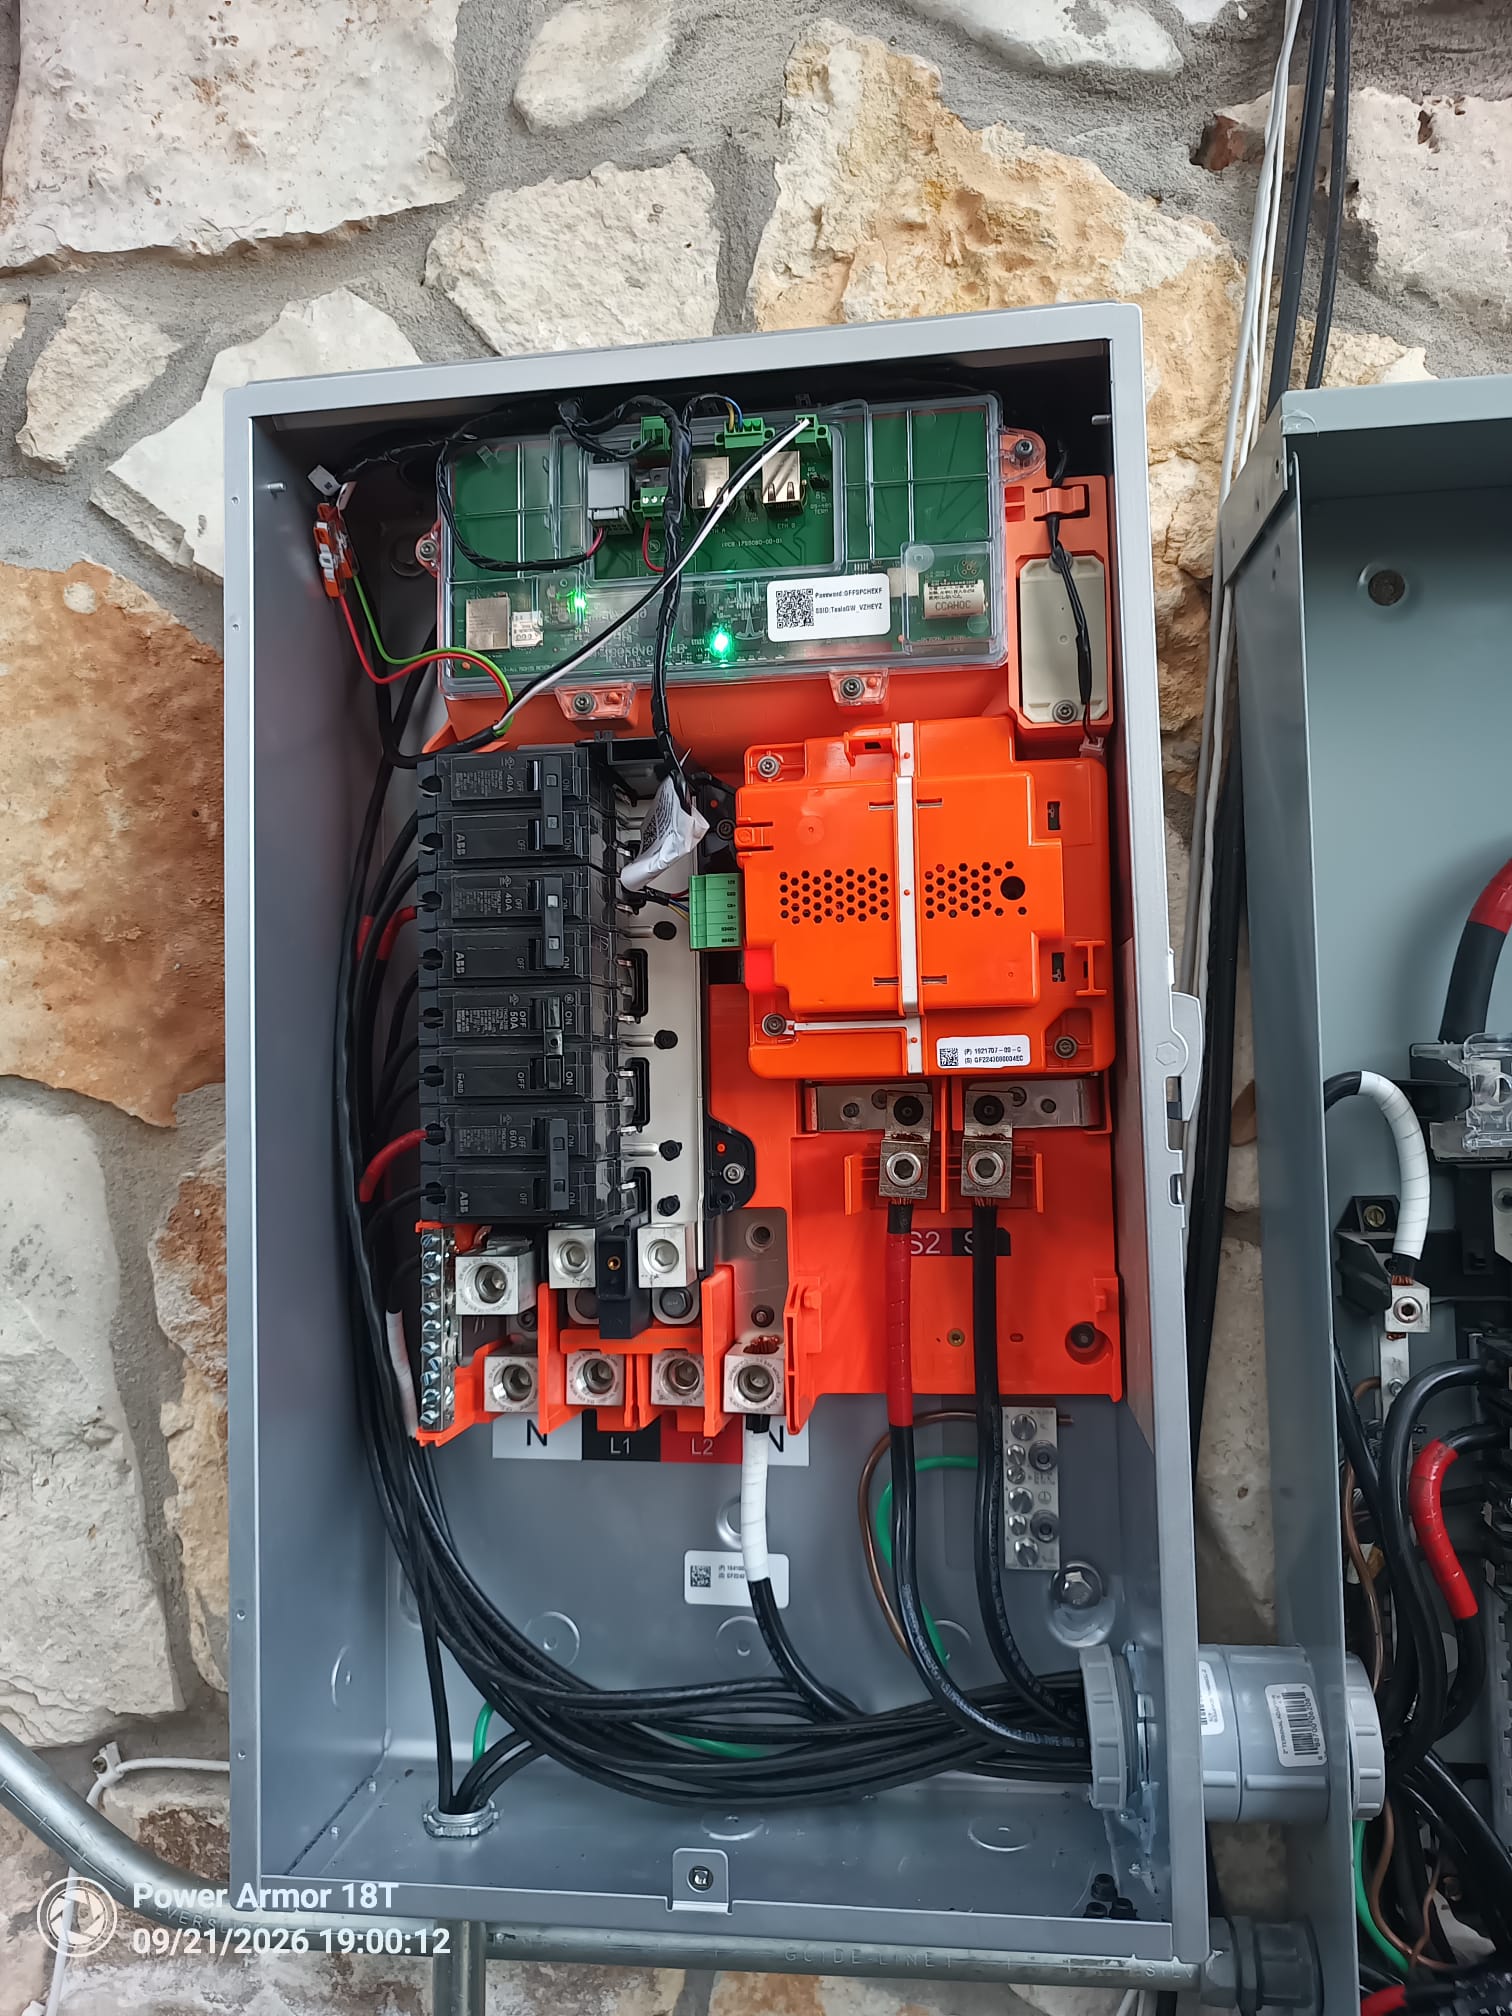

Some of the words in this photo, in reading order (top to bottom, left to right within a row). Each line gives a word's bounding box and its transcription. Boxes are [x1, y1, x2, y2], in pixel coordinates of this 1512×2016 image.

[506, 774, 514, 793] 40A
[505, 892, 513, 911] 40A
[509, 1011, 519, 1030] 50A
[519, 1010, 527, 1028] OFF
[564, 1010, 573, 1025] ON
[517, 1071, 525, 1089] OFF
[565, 1071, 574, 1086] ON
[509, 1129, 517, 1149] 60A
[518, 1135, 526, 1148] OFF
[459, 1191, 469, 1214] ABB
[519, 1192, 528, 1205] OFF
[910, 1231, 941, 1255] S2
[526, 1418, 548, 1447] N
[609, 1436, 631, 1455] L1
[690, 1436, 714, 1456] L2
